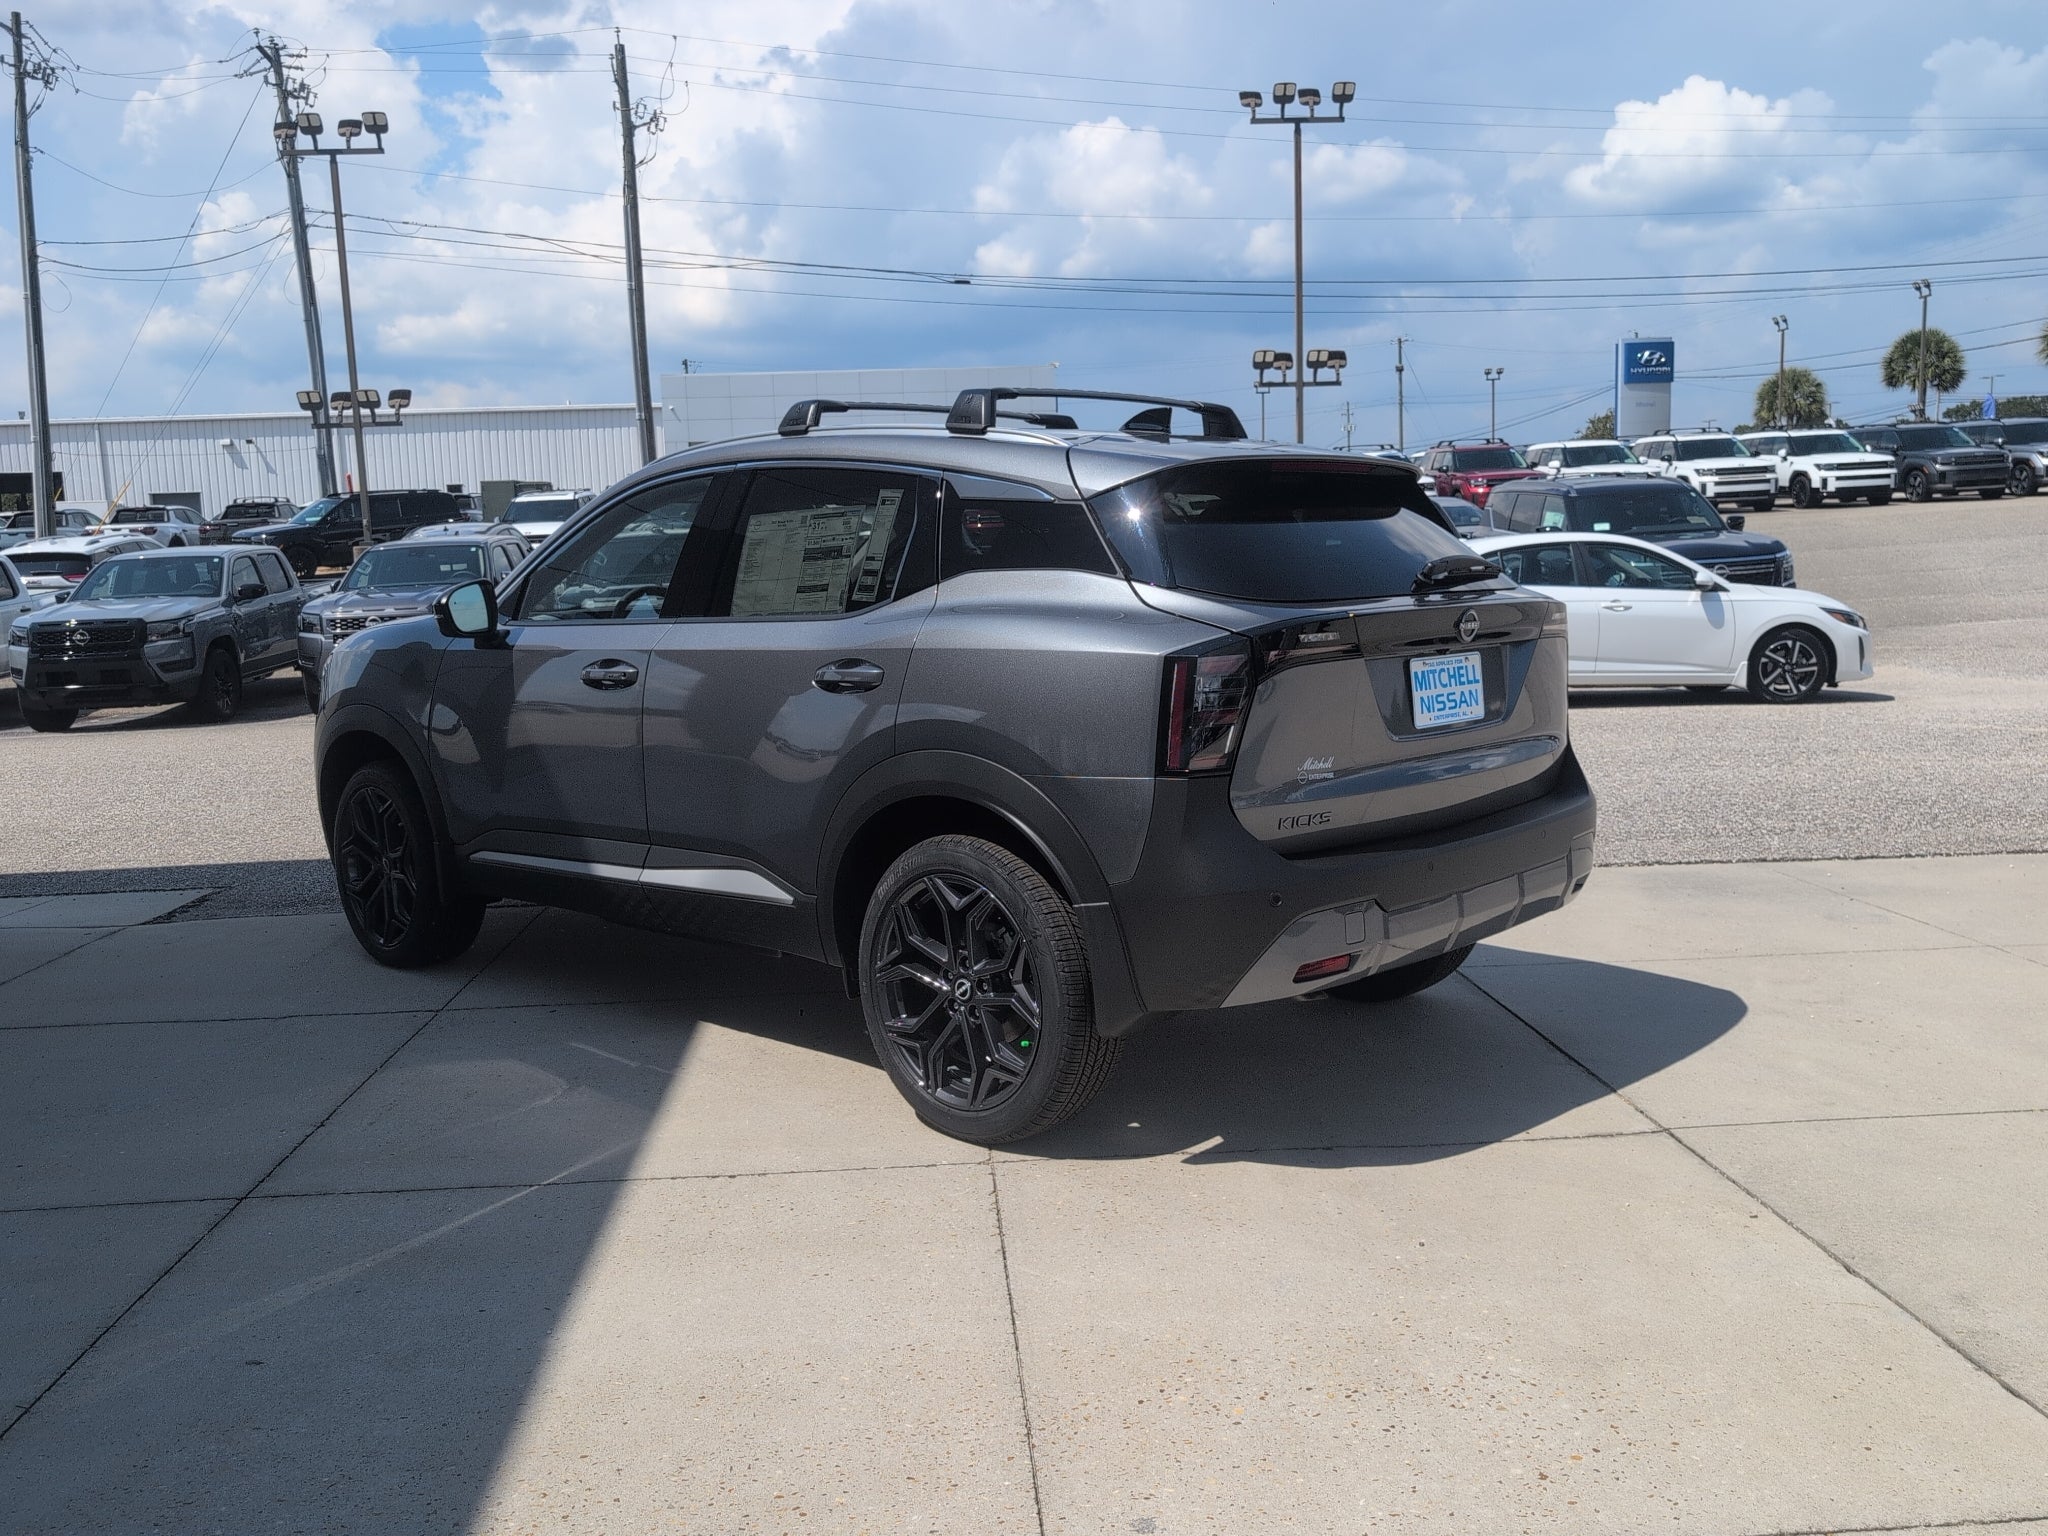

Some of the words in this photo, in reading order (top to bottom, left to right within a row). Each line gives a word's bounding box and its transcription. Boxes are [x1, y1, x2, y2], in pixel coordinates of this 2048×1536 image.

[1630, 366, 1671, 376] HYUNDAI
[1413, 664, 1480, 692] MITCHELL
[1420, 688, 1479, 714] NISSAN
[1297, 756, 1335, 771] Mitchell
[1278, 811, 1332, 830] KICKS
